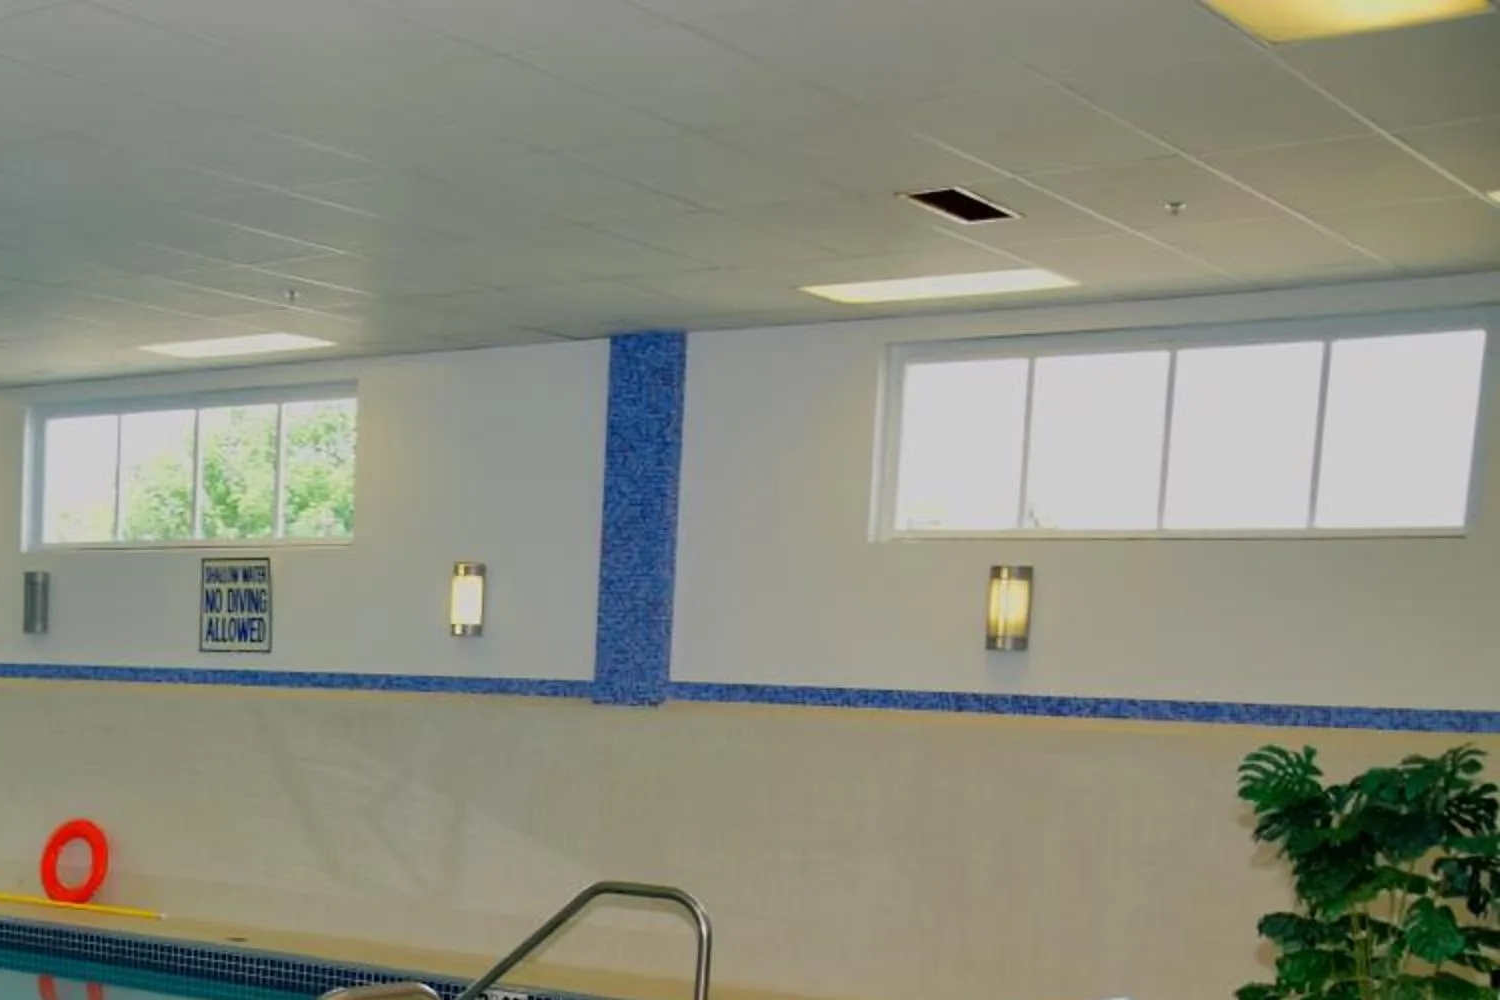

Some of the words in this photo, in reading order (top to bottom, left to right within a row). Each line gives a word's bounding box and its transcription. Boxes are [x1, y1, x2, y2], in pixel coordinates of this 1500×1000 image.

[205, 588, 223, 613] NO
[227, 588, 268, 613] DIVING
[205, 617, 267, 642] ALLOWED
